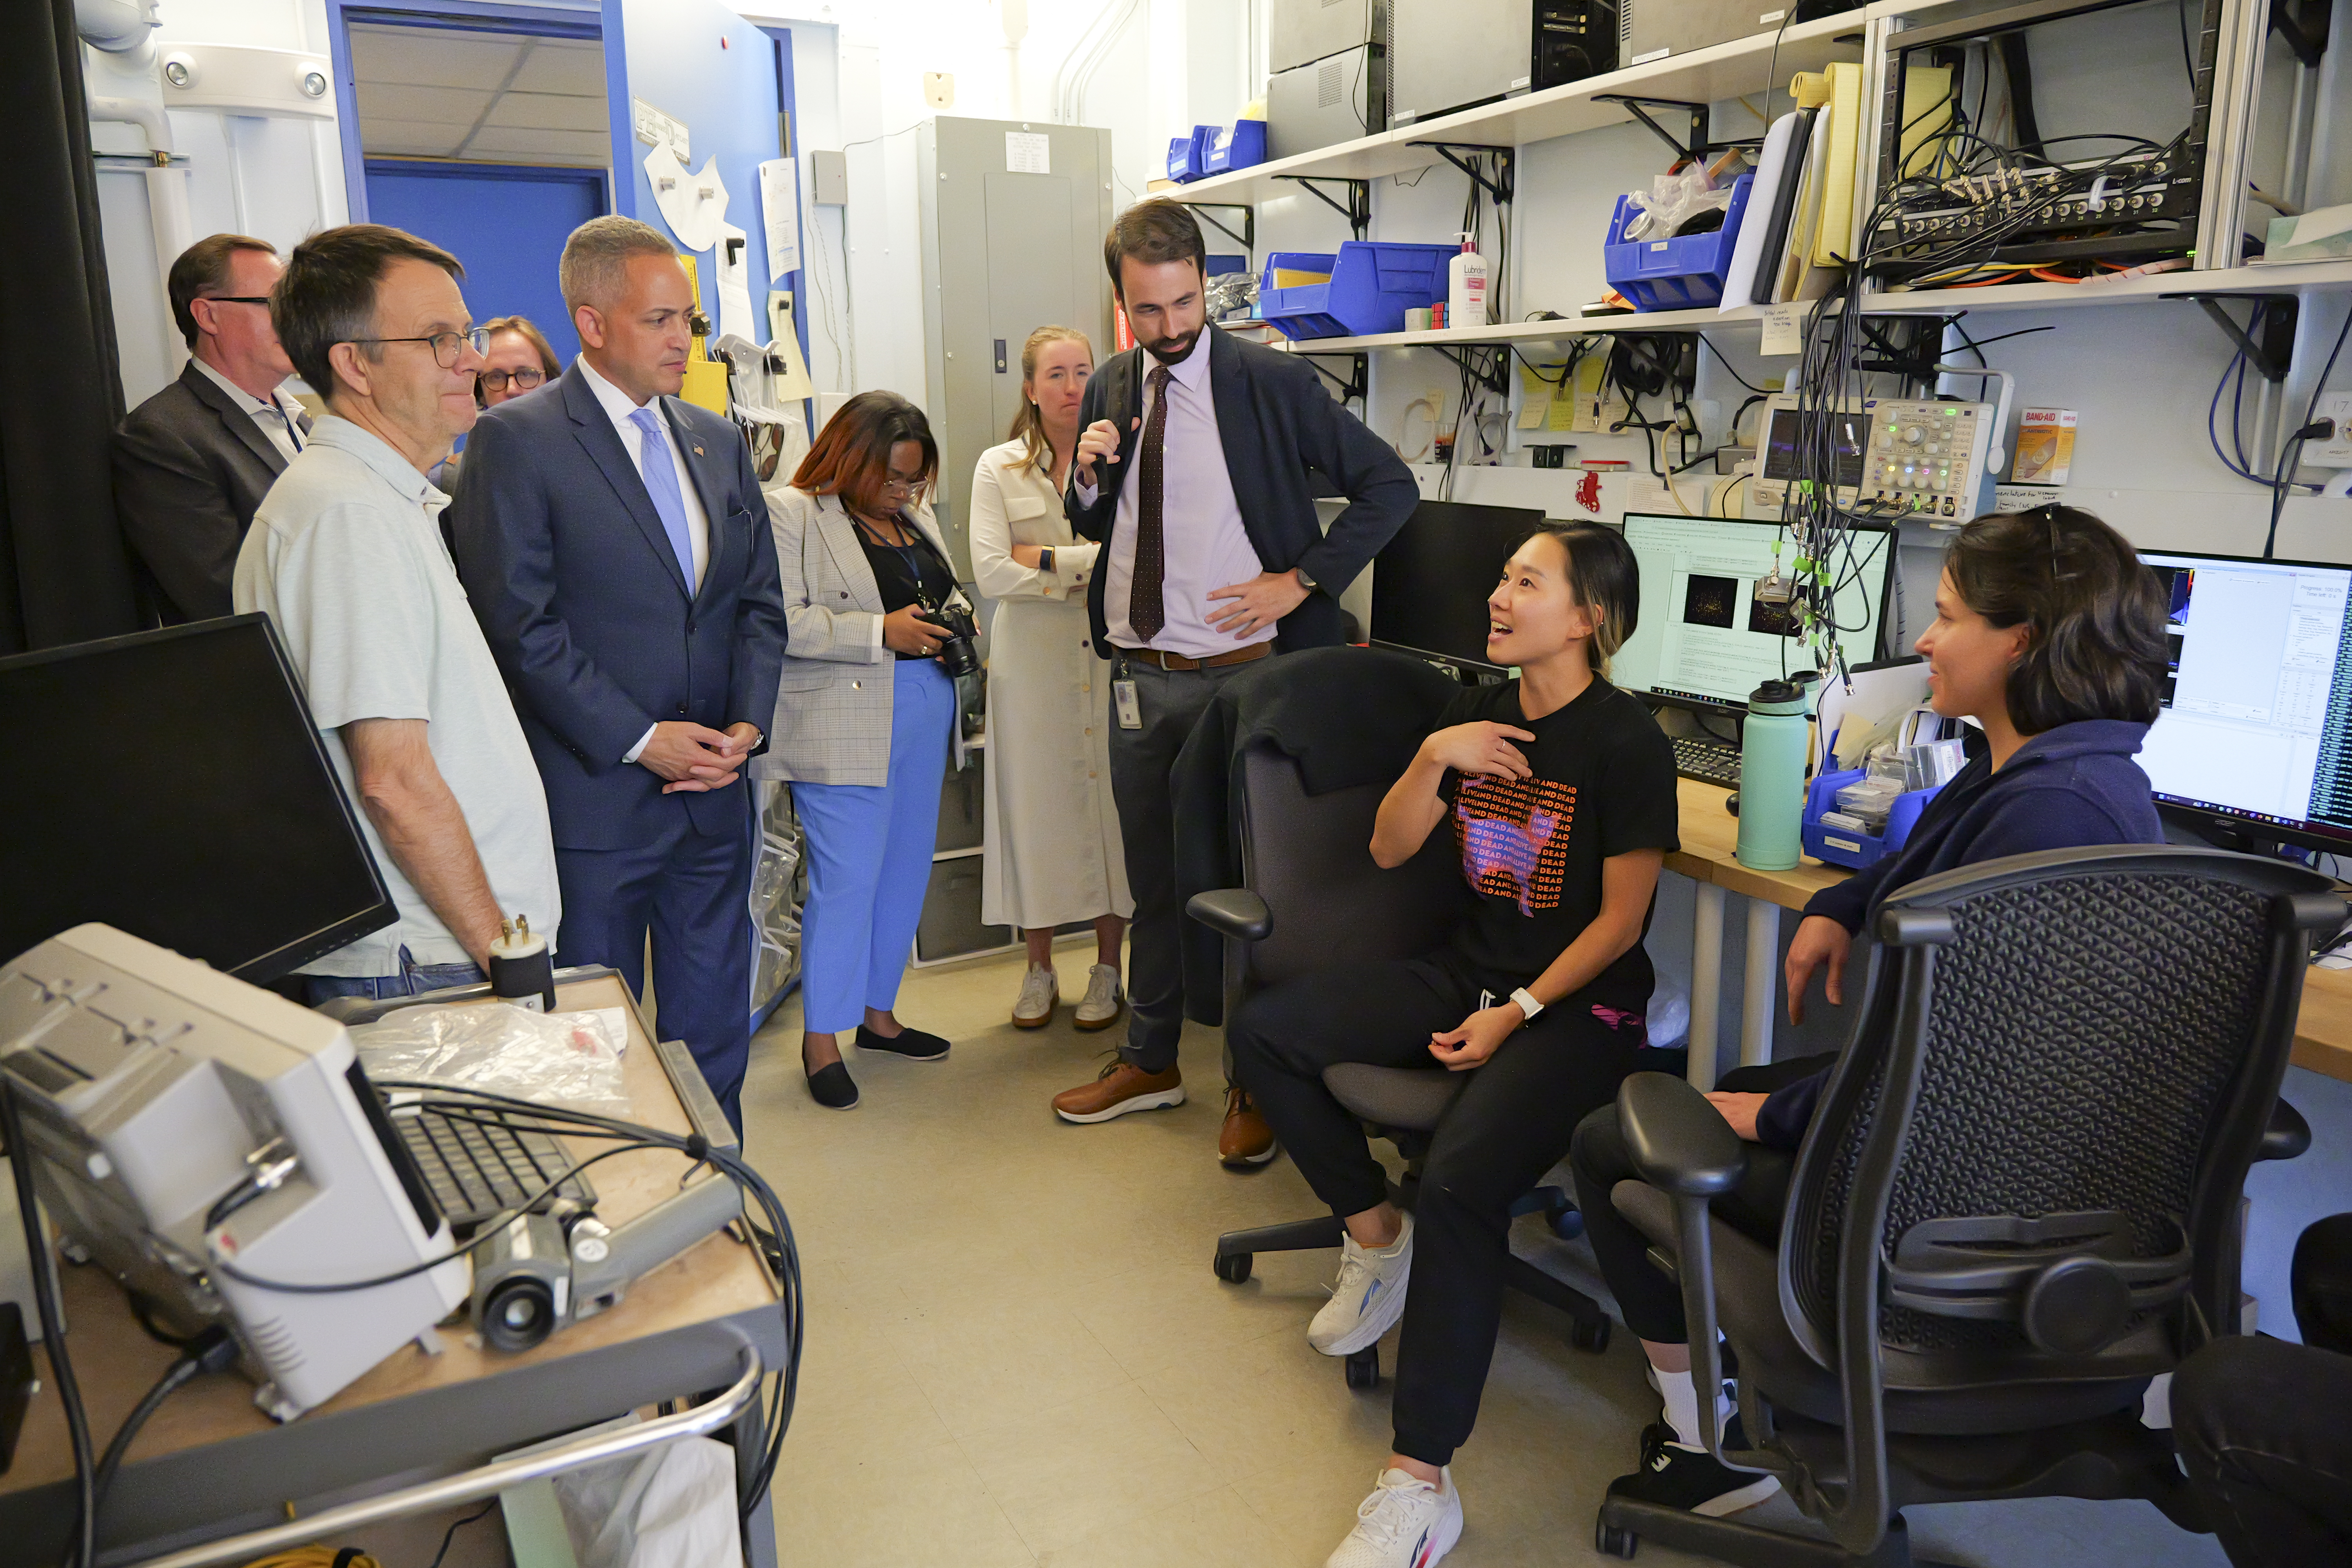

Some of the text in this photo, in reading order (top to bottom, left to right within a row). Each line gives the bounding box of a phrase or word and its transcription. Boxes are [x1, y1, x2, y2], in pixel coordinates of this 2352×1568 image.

[2026, 412, 2055, 421] BAND-AID
[2334, 401, 2349, 412] 17
[1495, 786, 1513, 796] DEAD
[1537, 799, 1553, 807] AND
[1554, 802, 1574, 813] DEAD
[1498, 778, 1516, 787] DEAD
[1539, 789, 1557, 798] AND
[1557, 793, 1575, 804] DEAD
[1541, 780, 1577, 794] AND DEAD
[1490, 804, 1509, 813] DEAD
[1548, 821, 1571, 831] DEAD
[1492, 795, 1510, 805] DEAD
[1510, 800, 1524, 809] AND
[1552, 811, 1572, 822] DEAD
[1485, 820, 1506, 831] DEAD
[1544, 840, 1568, 849] DEAD
[1487, 812, 1508, 821] DEAD
[1508, 818, 1520, 826] AND
[1546, 830, 1569, 840] DEAD
[1481, 839, 1503, 849] DEAD
[1541, 858, 1565, 867] DEAD
[1483, 830, 1505, 840] DEAD
[1543, 849, 1566, 858] DEAD
[1477, 858, 1499, 868] DEAD
[1479, 848, 1502, 858] DEAD
[1540, 867, 1564, 875] DEAD
[1498, 872, 1512, 880] AND
[1494, 888, 1512, 897] AND
